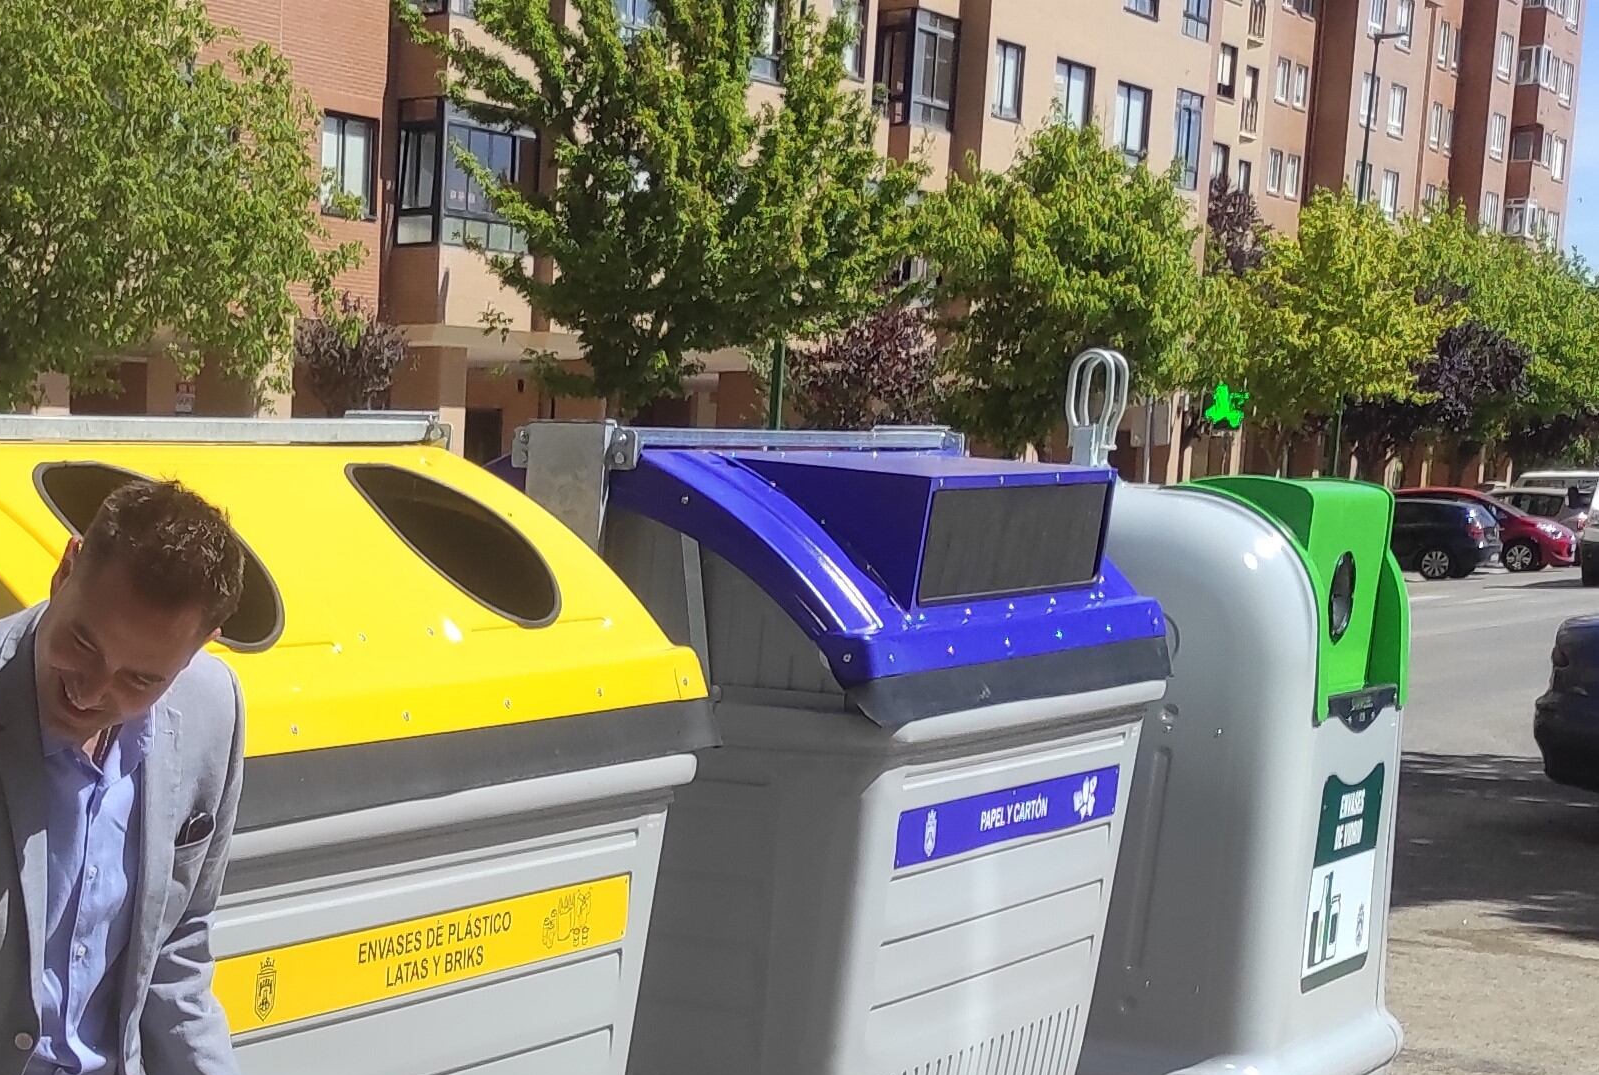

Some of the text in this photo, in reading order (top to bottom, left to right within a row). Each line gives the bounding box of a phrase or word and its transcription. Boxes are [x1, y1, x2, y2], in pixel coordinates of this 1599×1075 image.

[980, 793, 1049, 832] PAPEL Y CARTÓN
[358, 912, 512, 964] ENVASES DE PLÁSTICO
[386, 945, 484, 987] LATAS Y BRIKS
